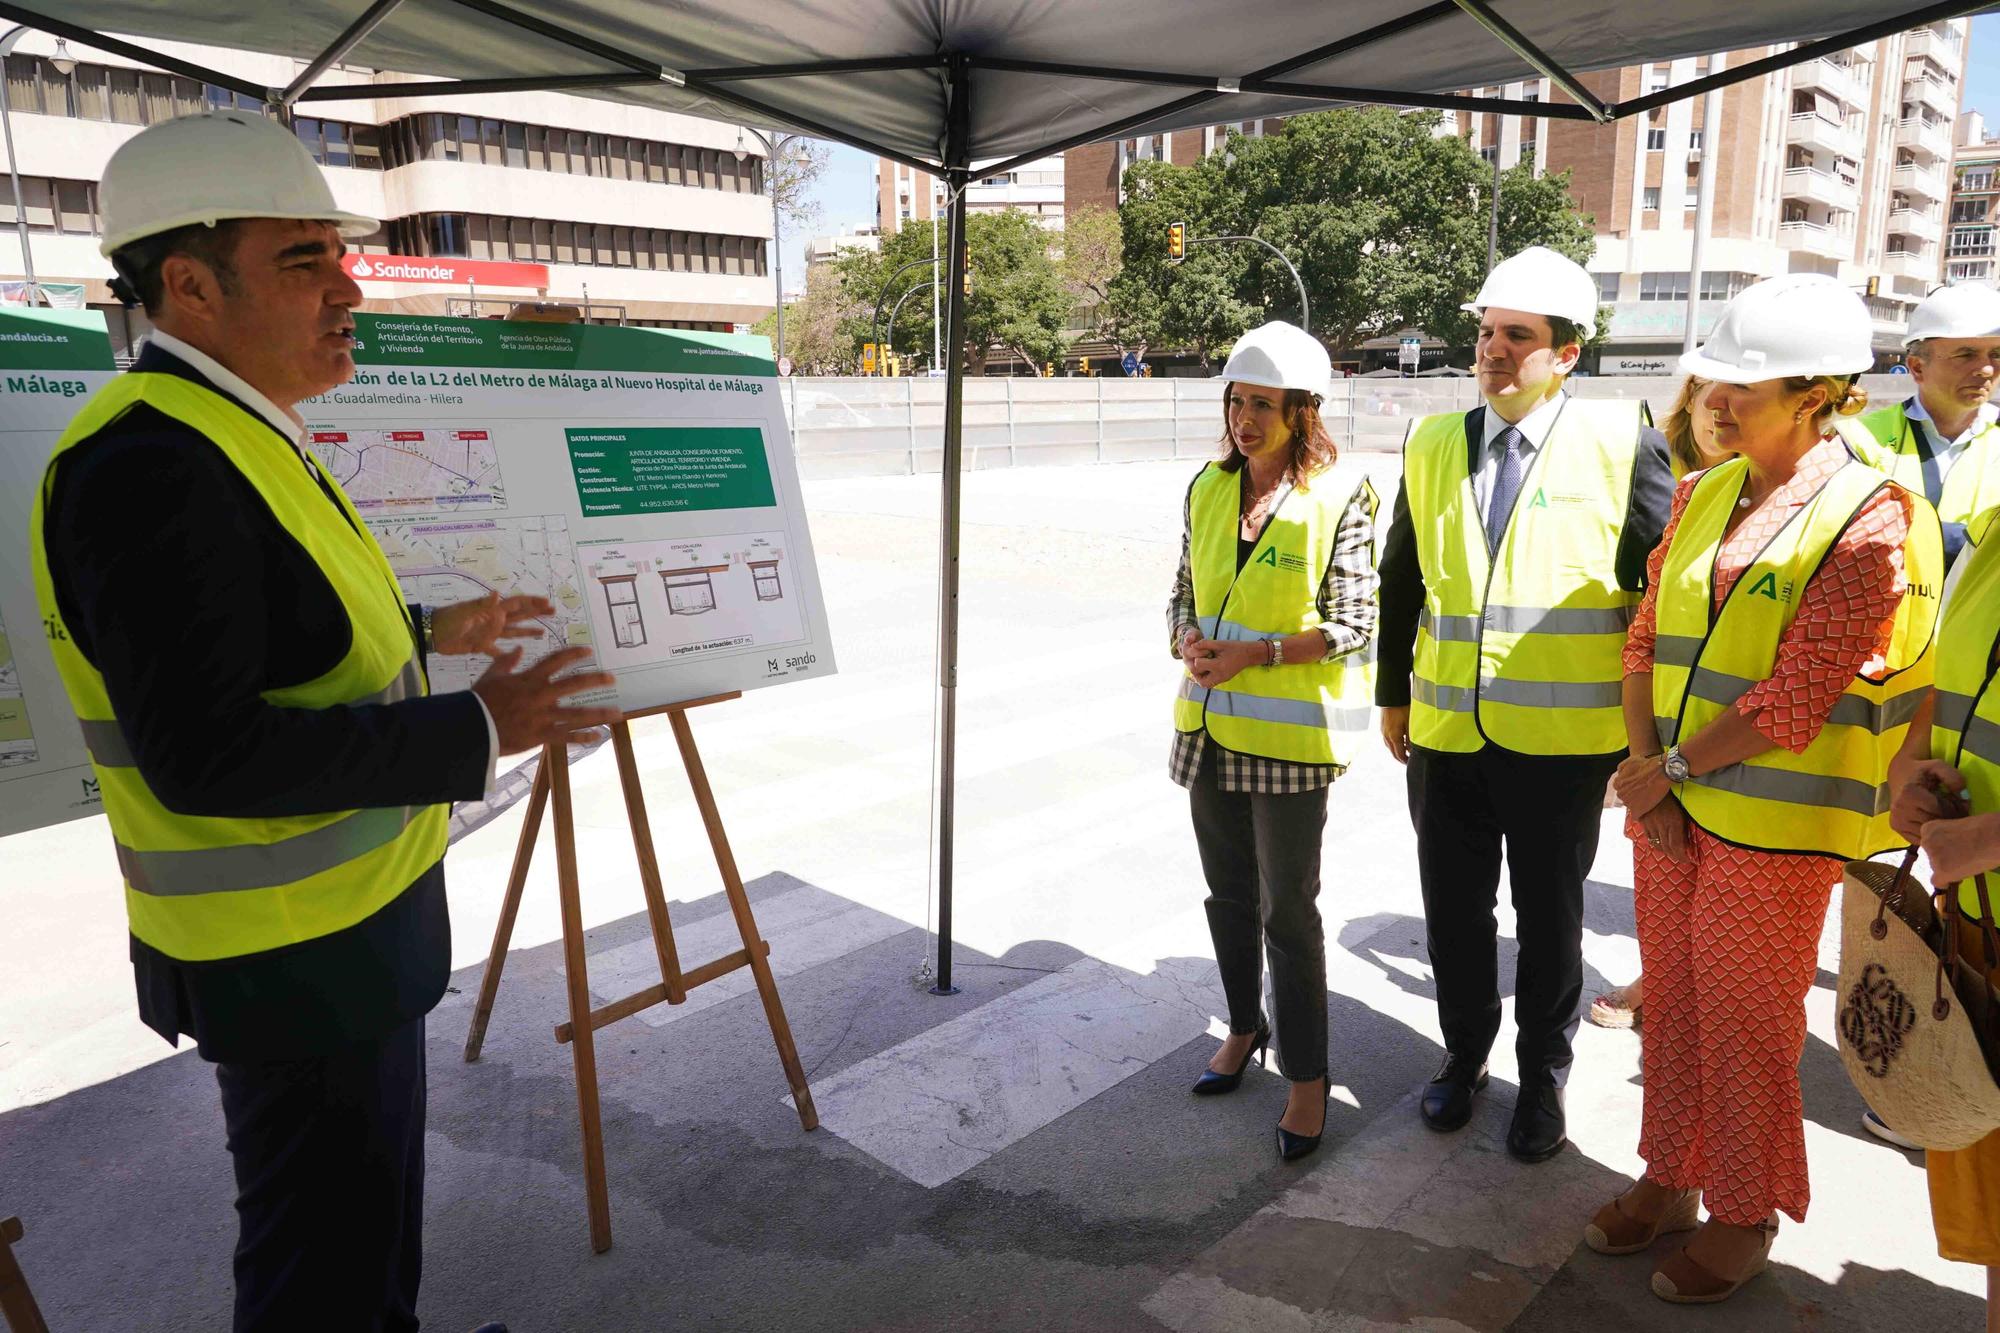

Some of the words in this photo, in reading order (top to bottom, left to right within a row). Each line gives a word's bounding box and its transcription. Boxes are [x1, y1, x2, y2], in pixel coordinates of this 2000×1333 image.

[374, 262, 454, 281] Santander
[375, 321, 421, 333] Consejería
[422, 323, 433, 332] de
[434, 324, 474, 335] Fomento,
[378, 332, 429, 343] Articulación
[431, 334, 444, 343] del
[446, 335, 483, 345] Territorio
[499, 334, 523, 343] Agencia
[533, 335, 548, 343] Obra
[380, 346, 386, 354] y
[386, 344, 424, 354] Vivienda
[7, 374, 87, 398] Málaga
[386, 371, 408, 386] de
[410, 371, 427, 386] la
[429, 373, 449, 387] L2
[453, 373, 478, 388] del
[480, 374, 524, 388] Metro
[528, 374, 546, 388] de
[548, 373, 598, 391] Málaga
[600, 375, 614, 389] al
[615, 377, 653, 390] Nuevo
[655, 377, 706, 394] Hospital
[708, 379, 723, 391] de
[725, 379, 764, 395] Málaga
[321, 393, 332, 404] 1:
[334, 392, 421, 405] Guadalmedina
[430, 393, 464, 404] Hilera
[671, 646, 694, 655] Longitud
[708, 640, 734, 650] actuación:
[785, 651, 817, 668] sando
